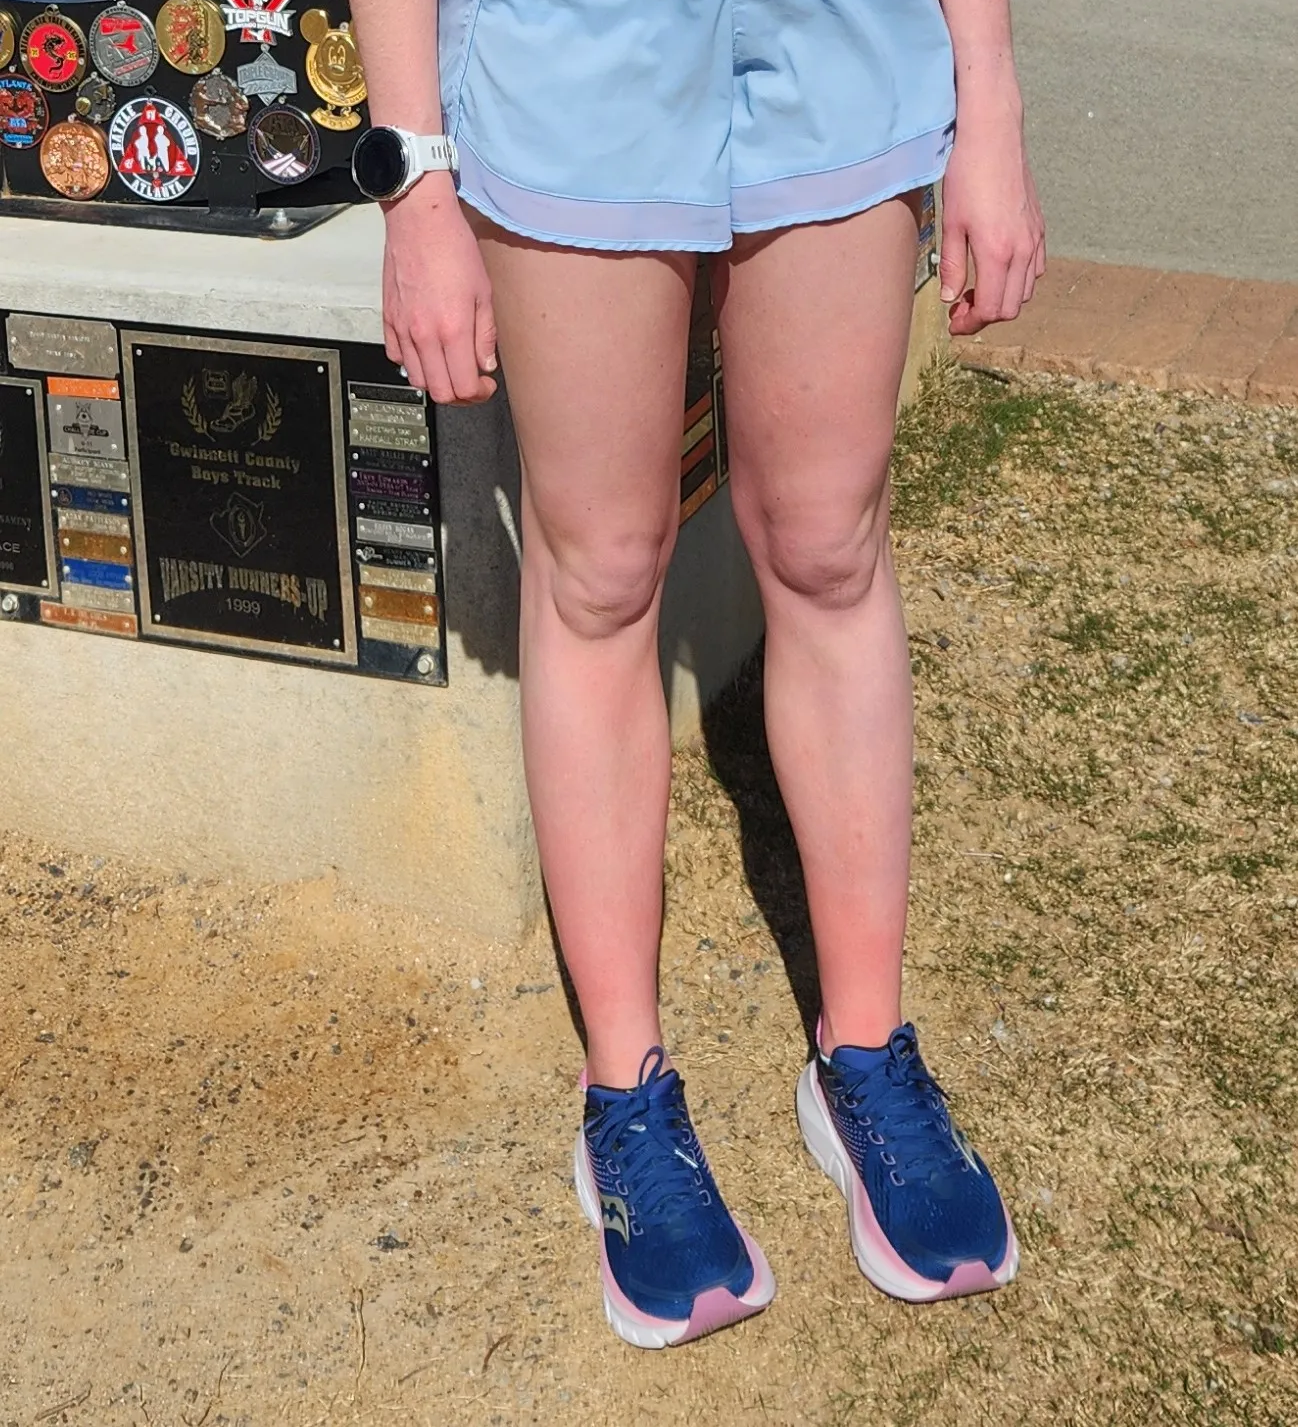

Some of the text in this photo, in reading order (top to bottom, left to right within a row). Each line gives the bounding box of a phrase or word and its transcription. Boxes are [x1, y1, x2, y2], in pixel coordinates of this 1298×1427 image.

[221, 7, 296, 31] TOPGUN
[112, 105, 198, 155] BATTLE GROUND
[131, 179, 184, 199] ATLANTA
[170, 441, 301, 474] Gwinnett County
[190, 465, 282, 489] Boys Track
[159, 556, 328, 621] VARSITY RUNNERS-UP
[226, 598, 261, 615] 1999
